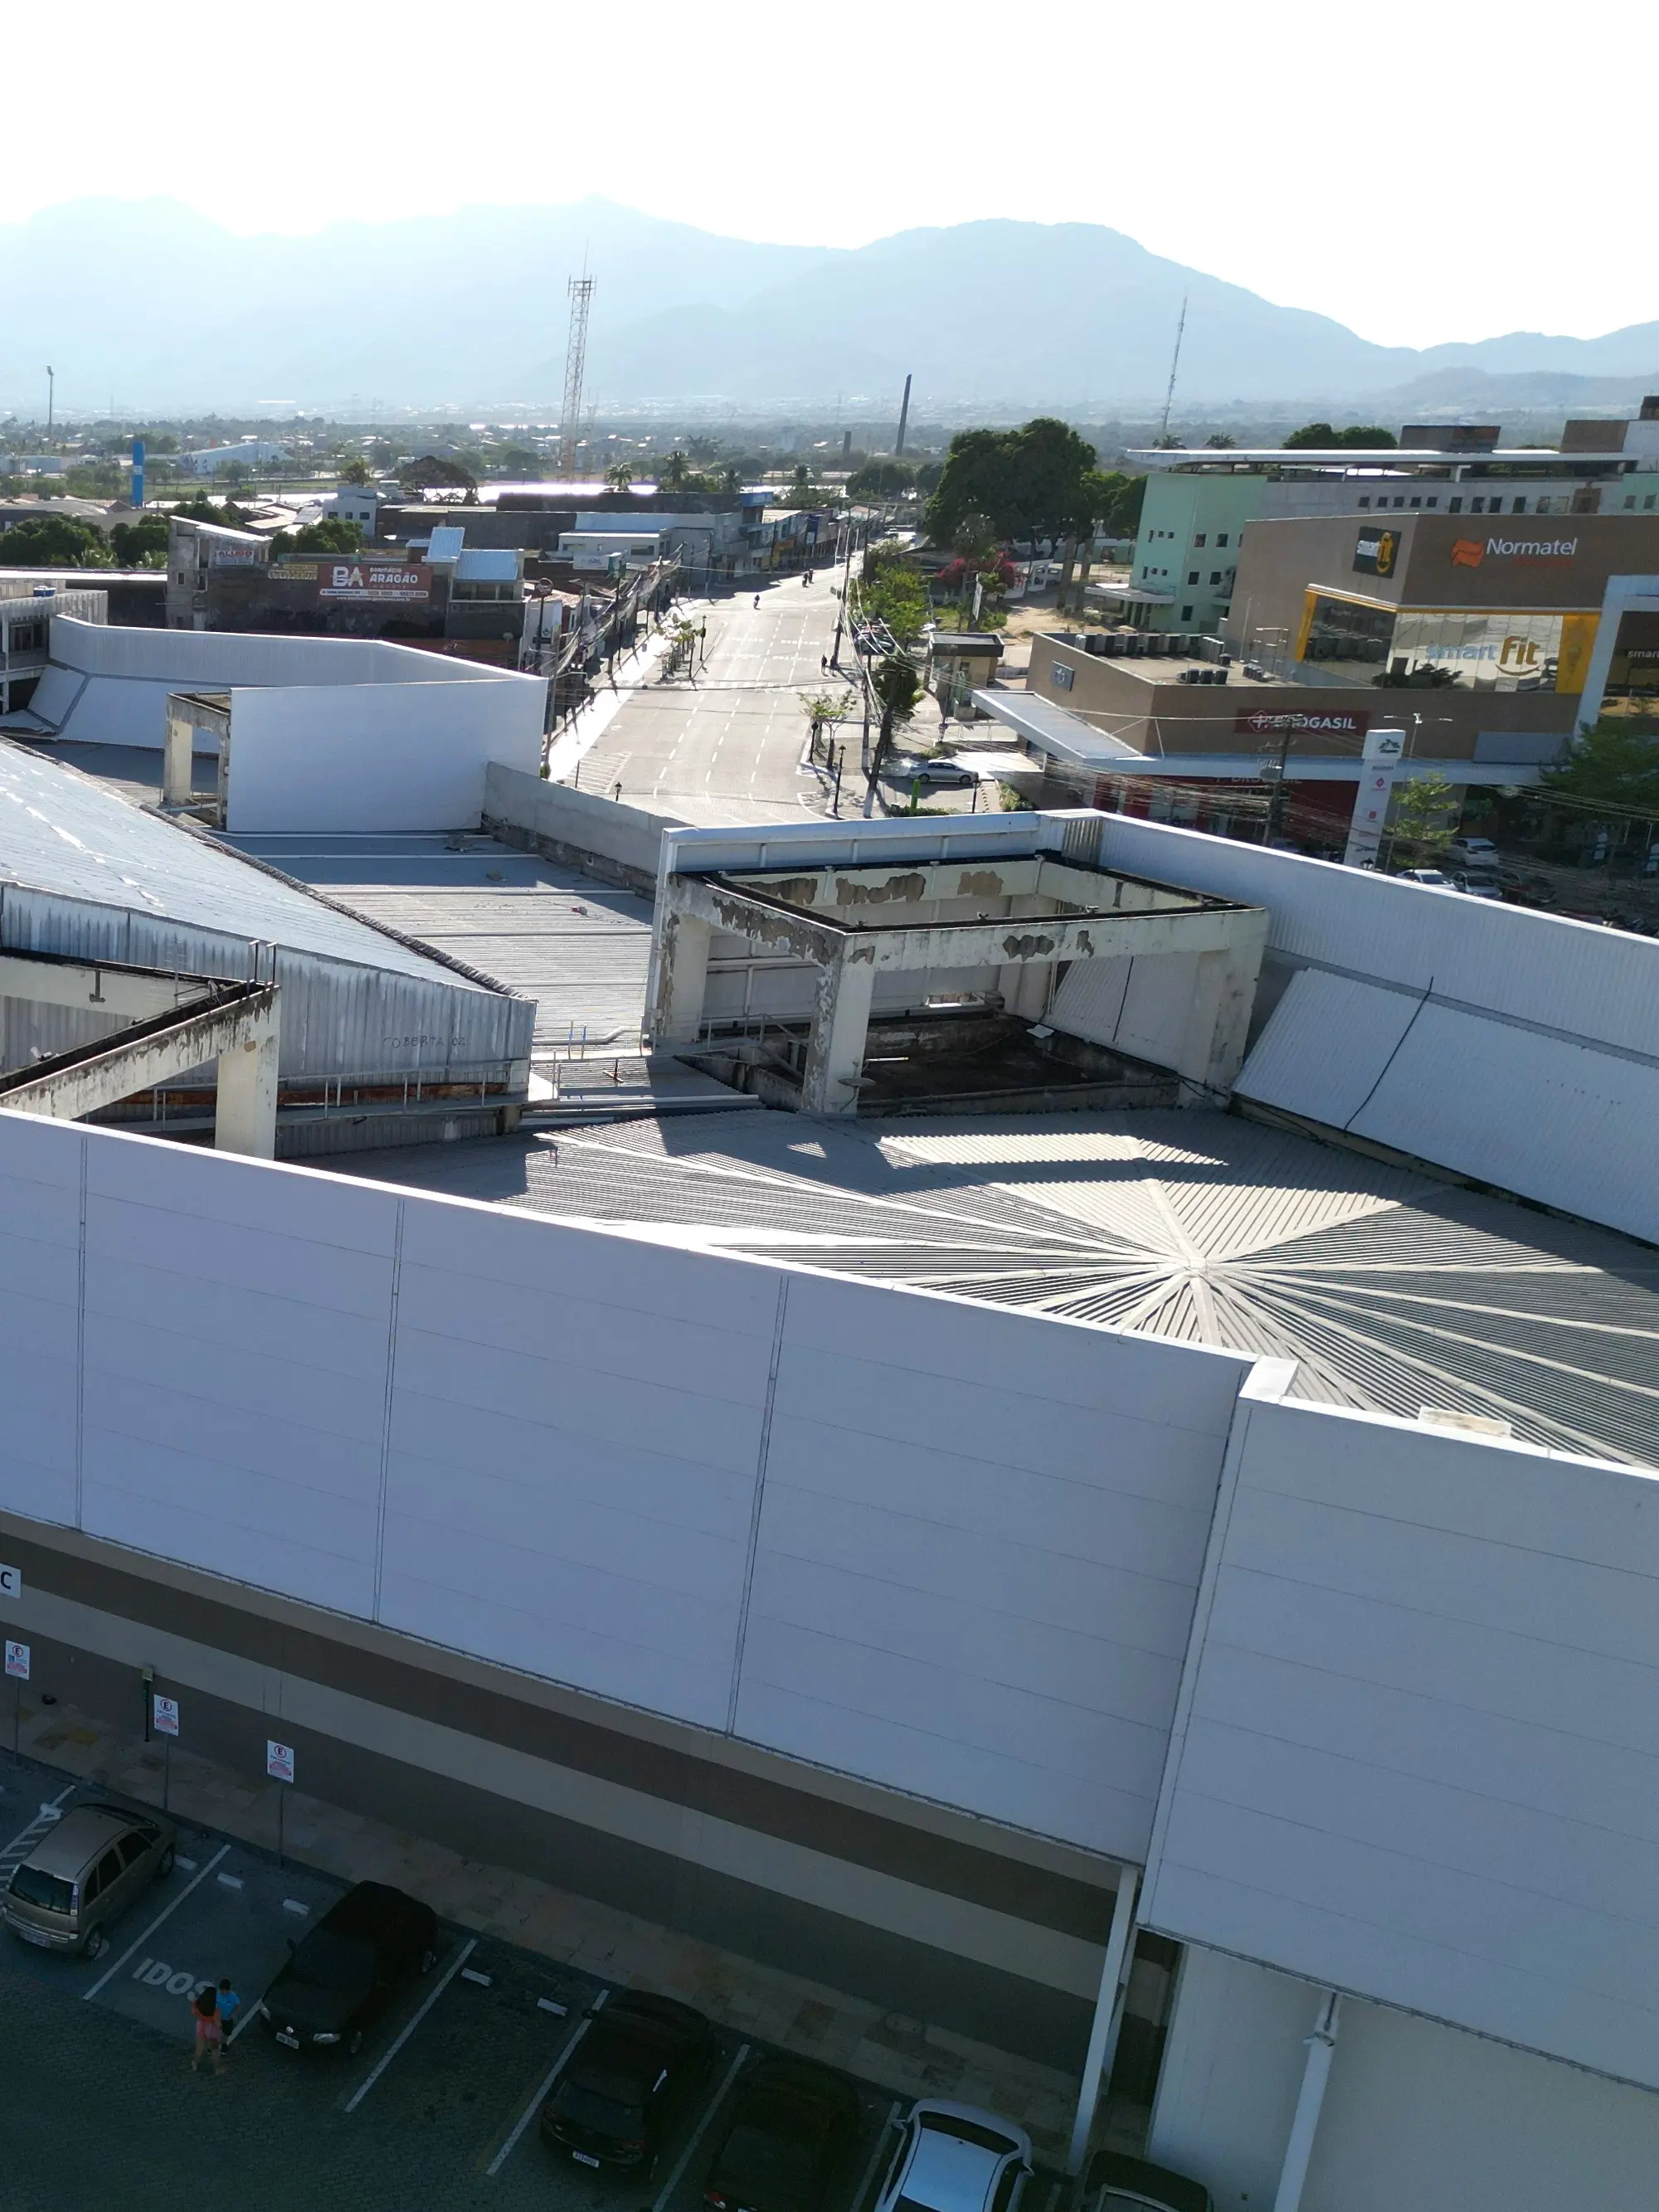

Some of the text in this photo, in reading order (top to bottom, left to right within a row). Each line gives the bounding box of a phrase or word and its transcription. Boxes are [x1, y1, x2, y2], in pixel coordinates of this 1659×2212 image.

[1486, 537, 1578, 556] Normatel
[333, 566, 363, 587] BA
[369, 571, 418, 584] ARAGÃO
[1426, 635, 1540, 665] smart fit
[1273, 714, 1357, 730] OGASIL
